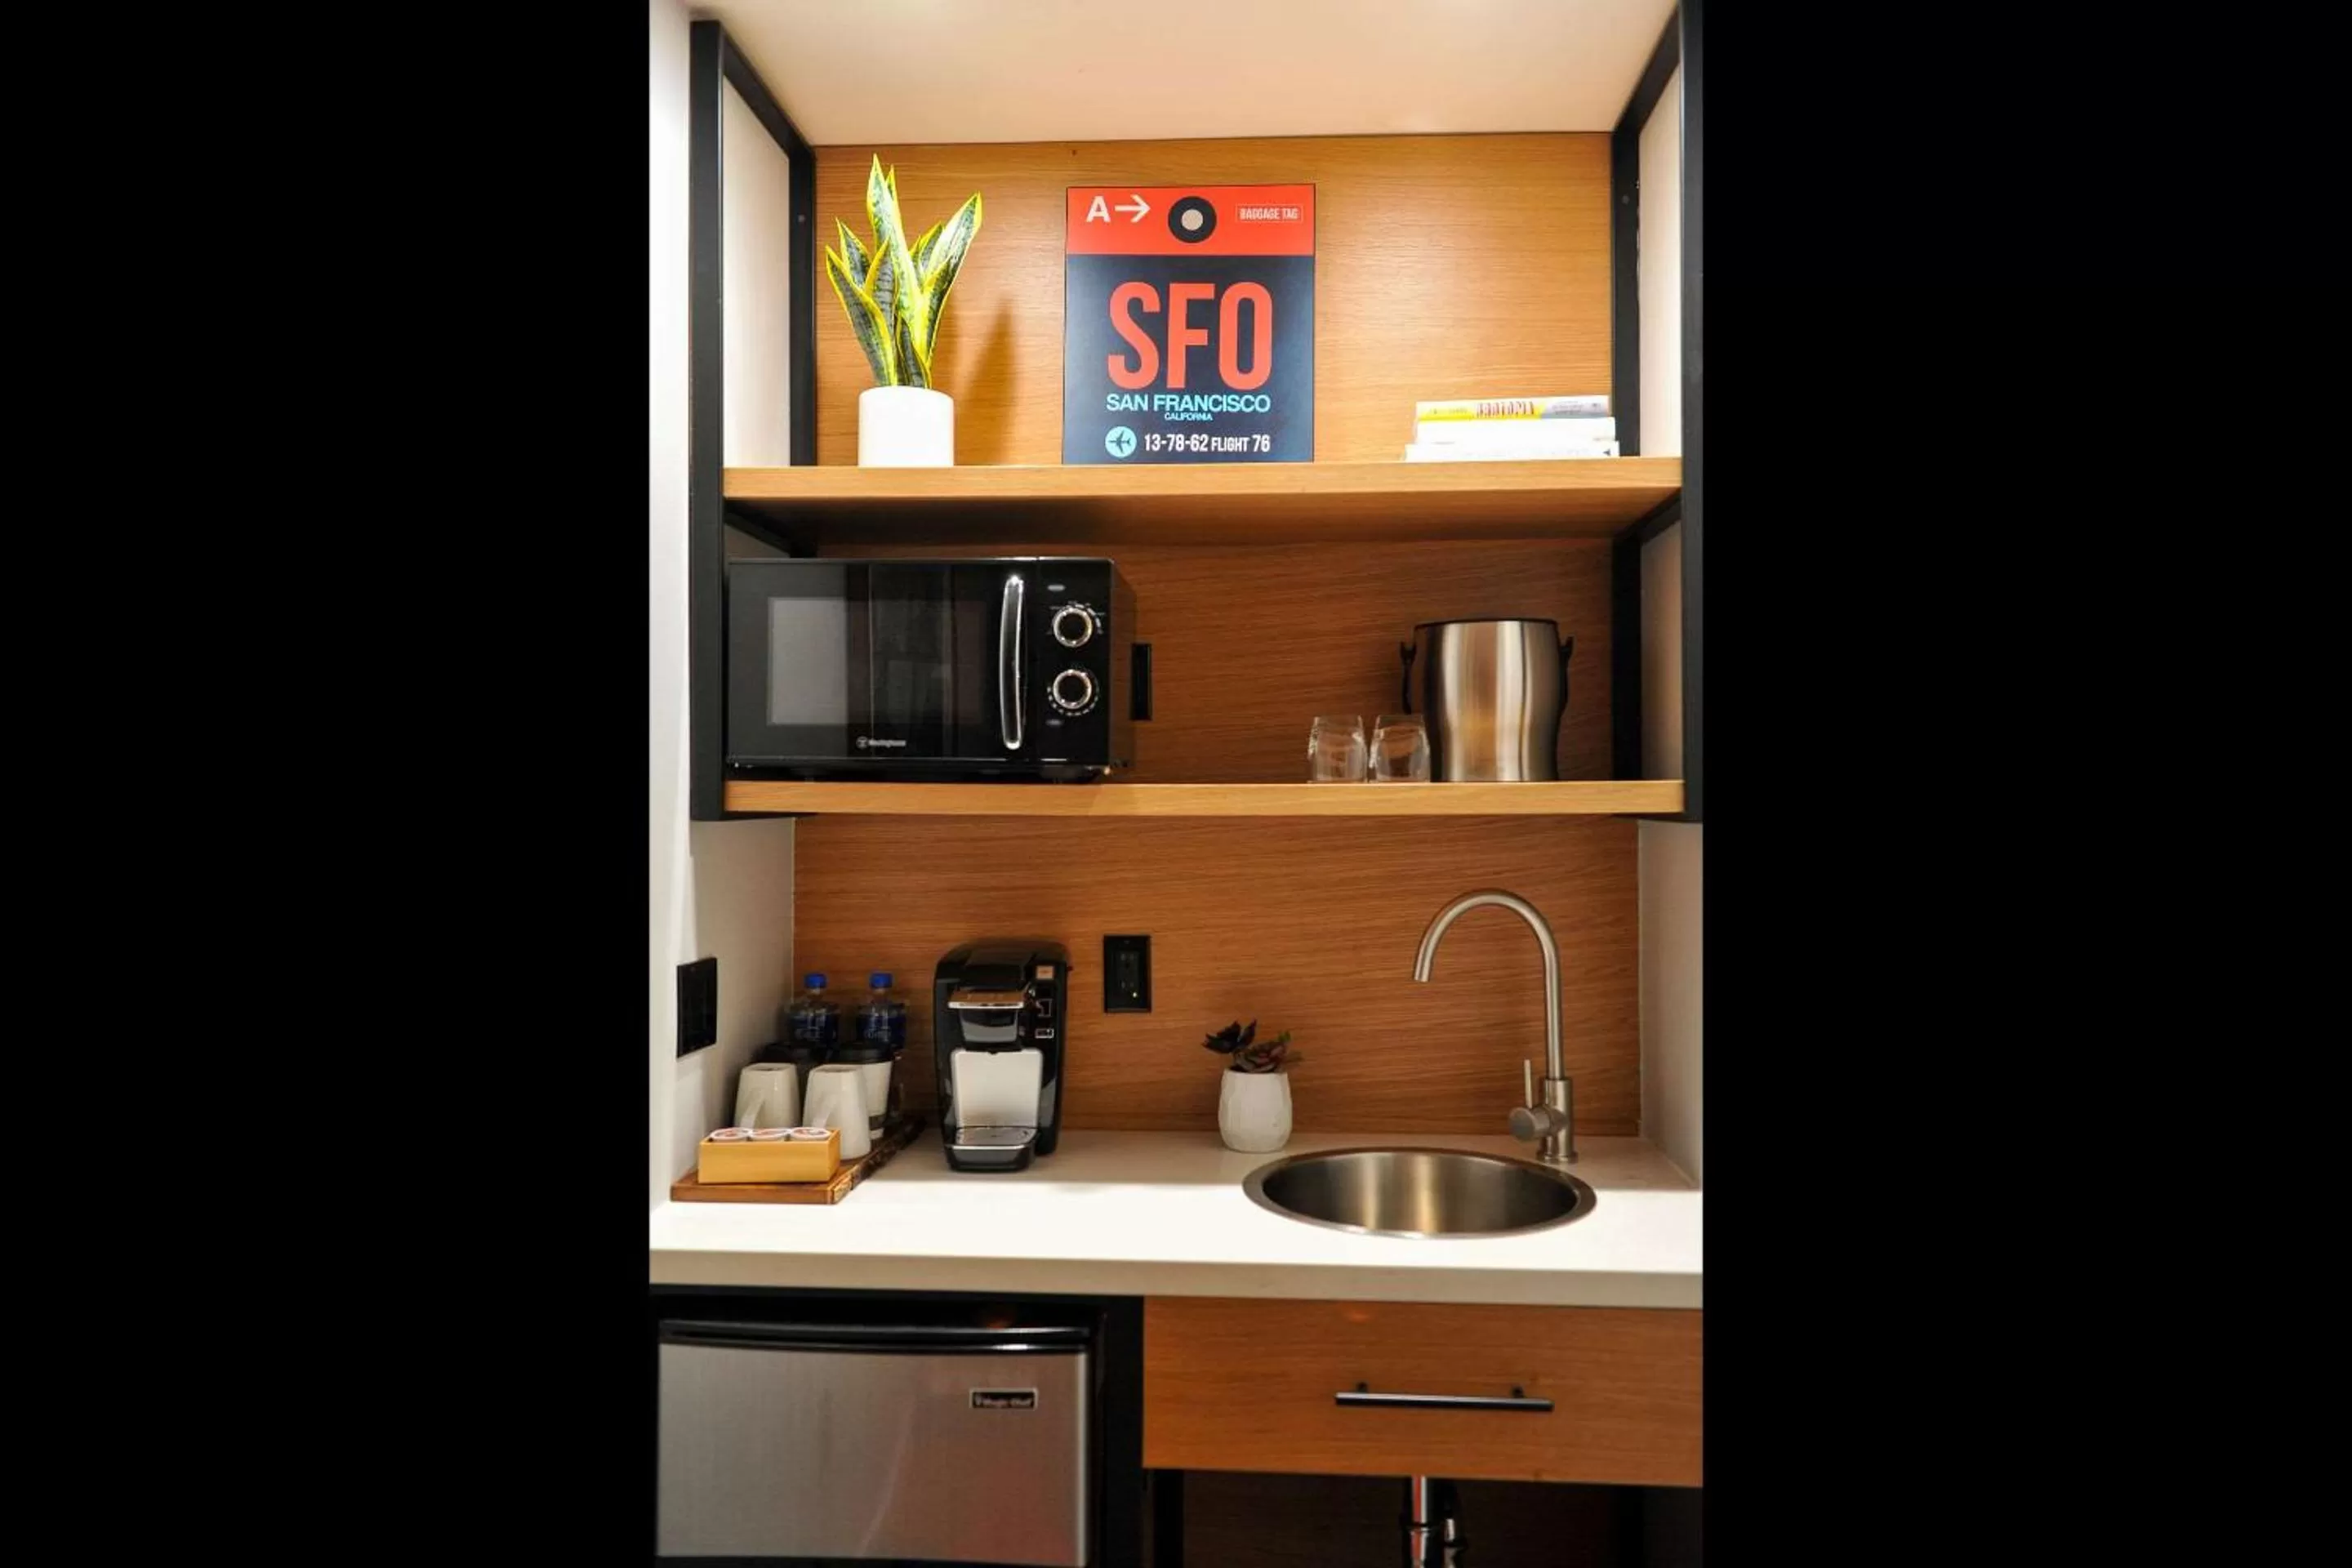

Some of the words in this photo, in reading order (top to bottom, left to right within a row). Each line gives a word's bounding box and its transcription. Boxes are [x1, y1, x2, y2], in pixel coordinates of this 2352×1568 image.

[1085, 195, 1111, 223] A
[1240, 207, 1281, 220] BAGGAGE
[1282, 207, 1298, 220] TAG
[1107, 281, 1273, 390] SFO
[1106, 394, 1149, 412] SAN
[1153, 394, 1272, 413] FRANCISCO
[1164, 412, 1214, 421] CALIFORNIA
[1144, 434, 1209, 452] 13-78-62
[1211, 436, 1250, 452] FLIGHT
[1252, 434, 1271, 452] 76
